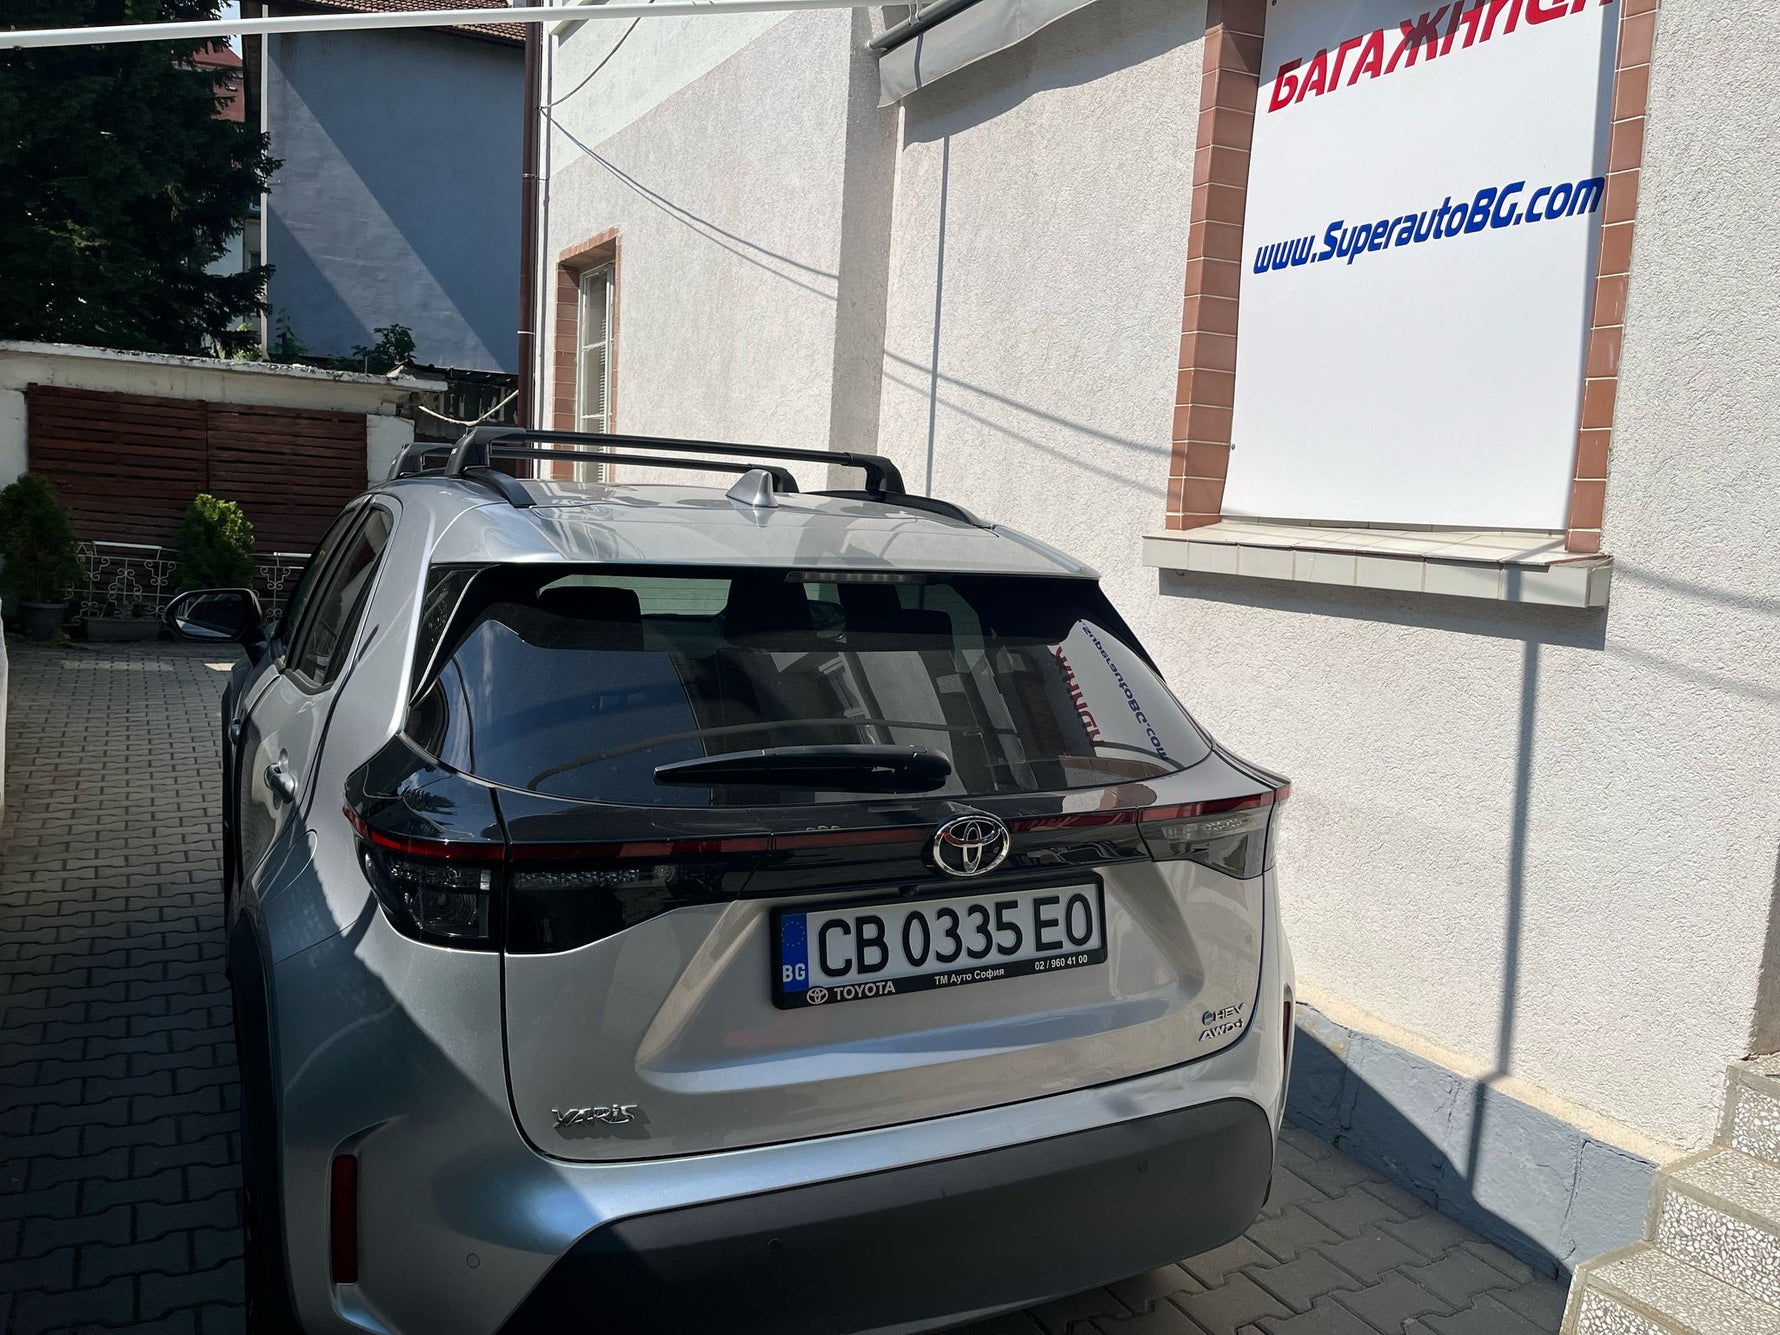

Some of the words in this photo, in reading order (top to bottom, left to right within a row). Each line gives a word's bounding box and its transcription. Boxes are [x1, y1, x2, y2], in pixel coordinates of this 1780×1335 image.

[1267, 0, 1614, 113] БАГАЖНИ
[1253, 176, 1606, 275] www.SuperautoBG.com
[818, 914, 889, 978] CB
[902, 900, 1024, 967] 0335
[1034, 961, 1046, 971] 02
[1051, 958, 1065, 969] 960
[1066, 955, 1076, 965] 41
[1078, 954, 1088, 964] 00
[782, 963, 806, 983] BG
[950, 972, 972, 985] Ауто
[974, 967, 1005, 980] София
[834, 981, 896, 1000] TOYOTA
